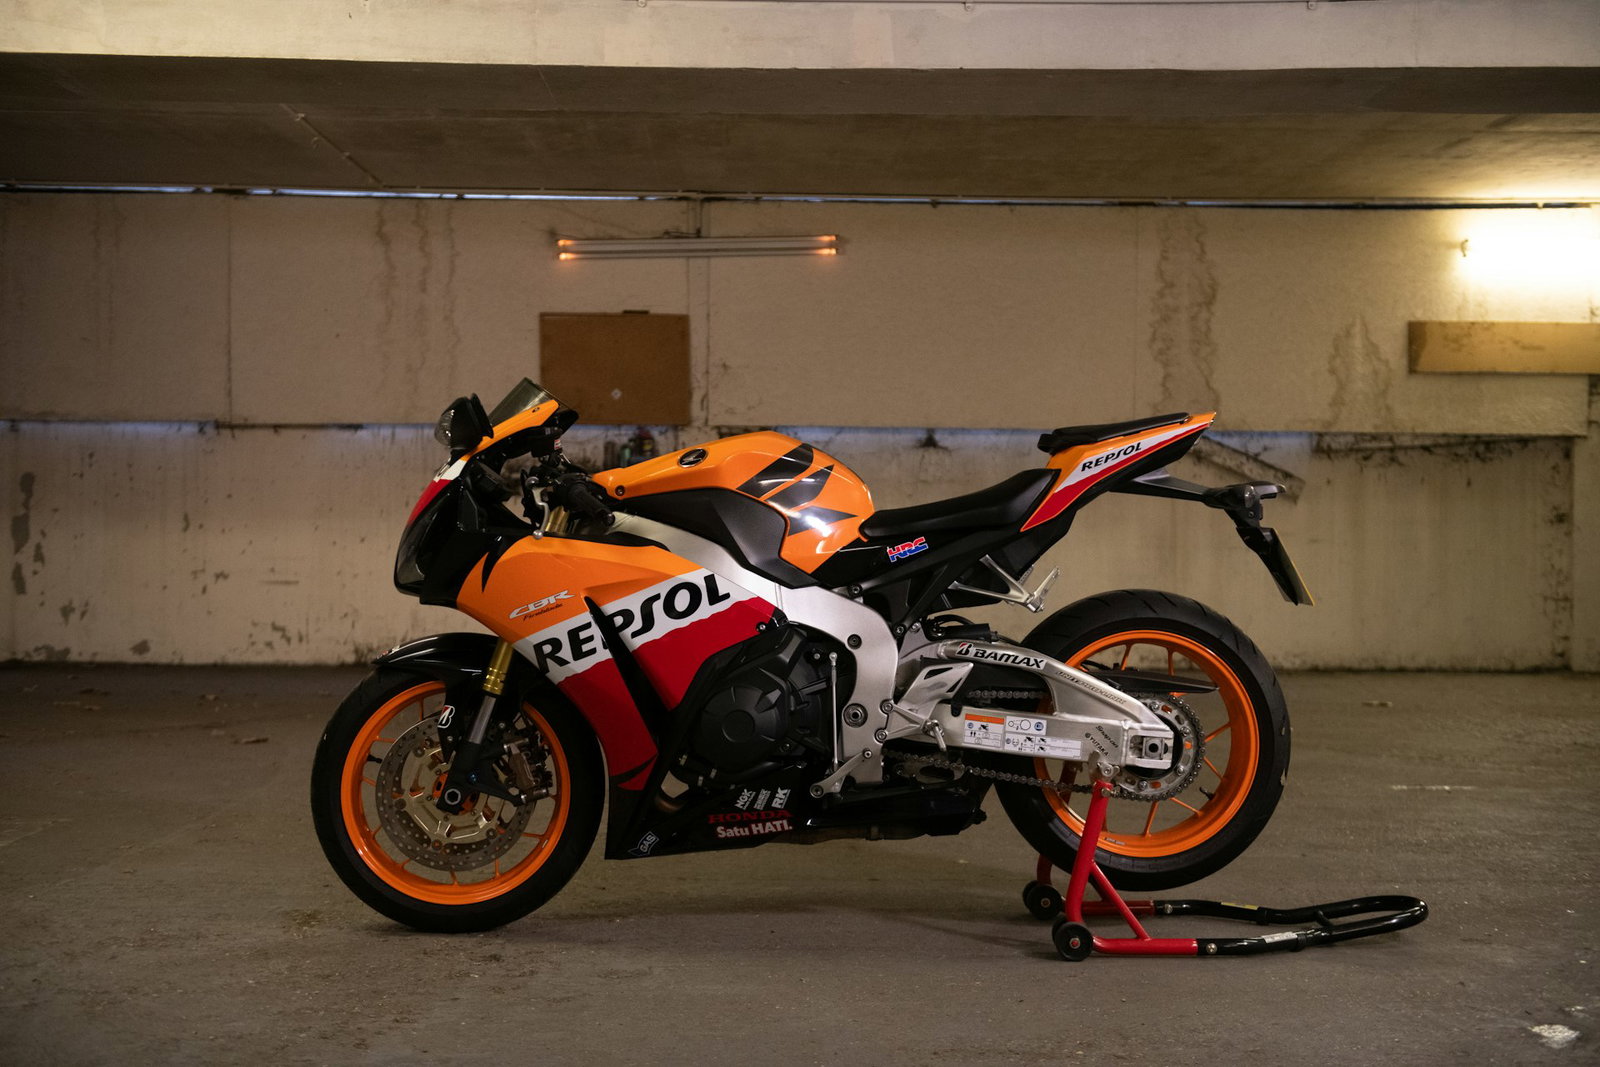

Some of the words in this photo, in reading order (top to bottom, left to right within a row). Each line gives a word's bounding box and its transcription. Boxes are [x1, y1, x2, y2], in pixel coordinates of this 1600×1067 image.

[1081, 442, 1142, 472] REPSOL
[509, 589, 576, 619] CBR
[533, 573, 731, 675] REPSOL
[734, 788, 753, 809] NGK
[771, 787, 789, 808] RK
[708, 810, 793, 824] HONDA
[716, 825, 750, 838] Satu
[639, 834, 657, 853] GAS
